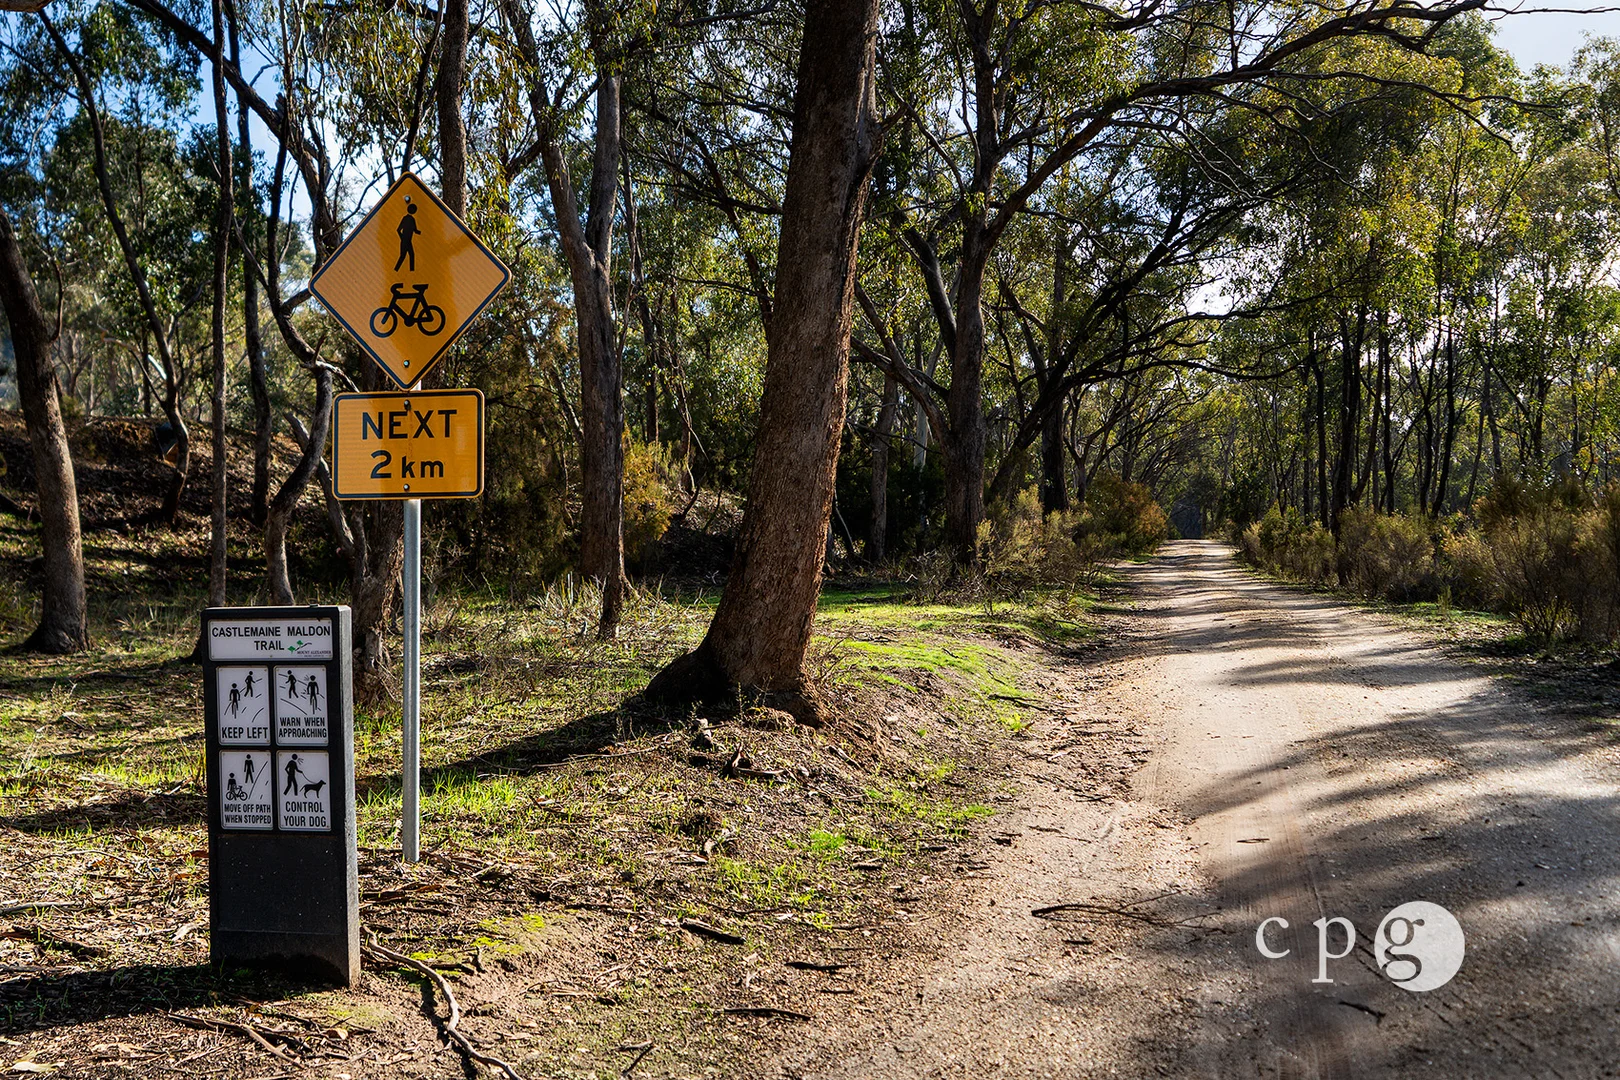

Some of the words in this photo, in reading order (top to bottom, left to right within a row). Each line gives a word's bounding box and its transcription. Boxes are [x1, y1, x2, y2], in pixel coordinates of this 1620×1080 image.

[362, 409, 457, 440] NEXT
[370, 450, 392, 479] 2
[401, 456, 444, 478] km
[211, 626, 281, 637] CASTLEMAINE
[287, 625, 331, 636] MALDON
[254, 640, 285, 651] TRAIL
[279, 717, 301, 727] WARN
[304, 717, 325, 727] WHEN
[221, 727, 244, 739] KEEP
[247, 727, 268, 739] LEFT
[278, 727, 327, 738] APPROACHING
[224, 803, 241, 813] MOVE
[243, 803, 254, 813] OFF
[255, 803, 271, 813] PATH
[285, 801, 325, 813] CONTROL
[225, 814, 243, 824] WHEN
[244, 814, 271, 824] STOPPED
[284, 815, 306, 827] YOUR
[309, 816, 327, 828] DOG
